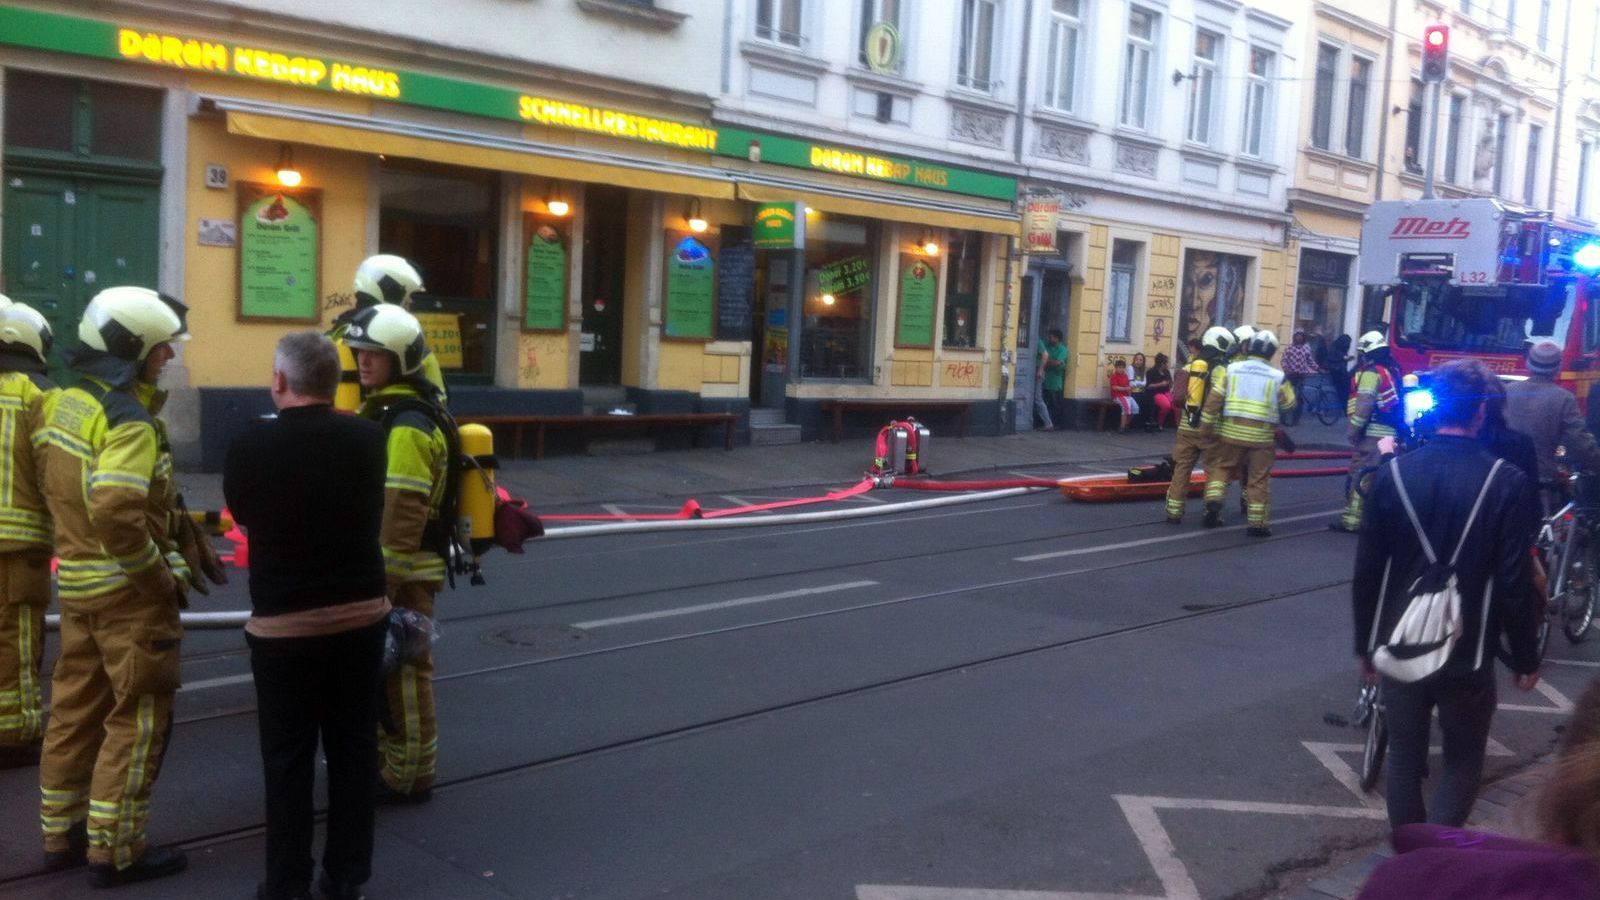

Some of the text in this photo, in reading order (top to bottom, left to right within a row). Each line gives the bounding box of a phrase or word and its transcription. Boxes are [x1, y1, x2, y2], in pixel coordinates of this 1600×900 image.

[234, 47, 326, 85] KEBAP
[331, 63, 400, 97] HAUS
[519, 95, 718, 149] SCHNELLRESTAURANT
[210, 168, 227, 184] 39
[866, 156, 911, 179] KEBAP
[915, 167, 947, 186] HAUS
[1389, 217, 1471, 240] Metz
[1460, 271, 1487, 283] L32
